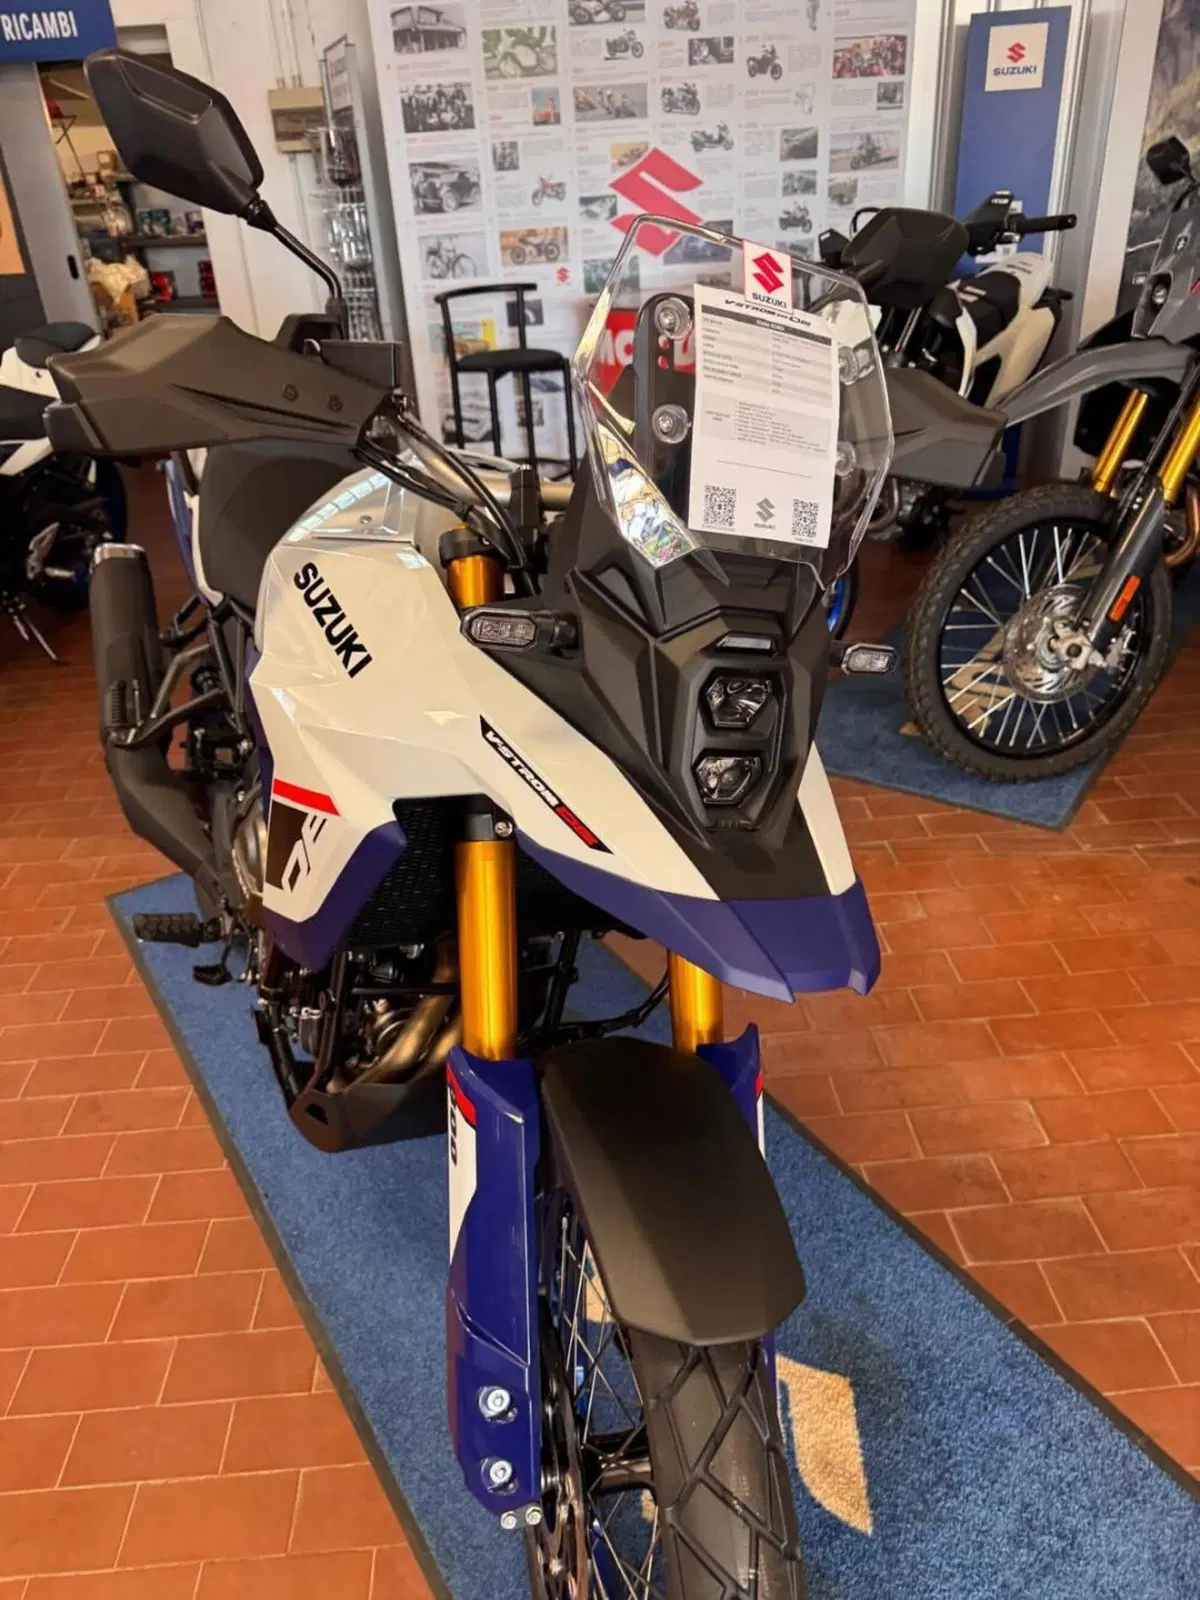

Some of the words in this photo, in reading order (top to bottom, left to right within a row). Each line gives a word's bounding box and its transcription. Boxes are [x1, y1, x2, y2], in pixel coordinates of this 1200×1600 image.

[0, 10, 78, 41] RICAMBI
[993, 65, 1037, 76] SUZUKI
[751, 292, 787, 309] SUZUKI
[293, 562, 373, 679] SUZUKI
[485, 730, 561, 808] V-STROM
